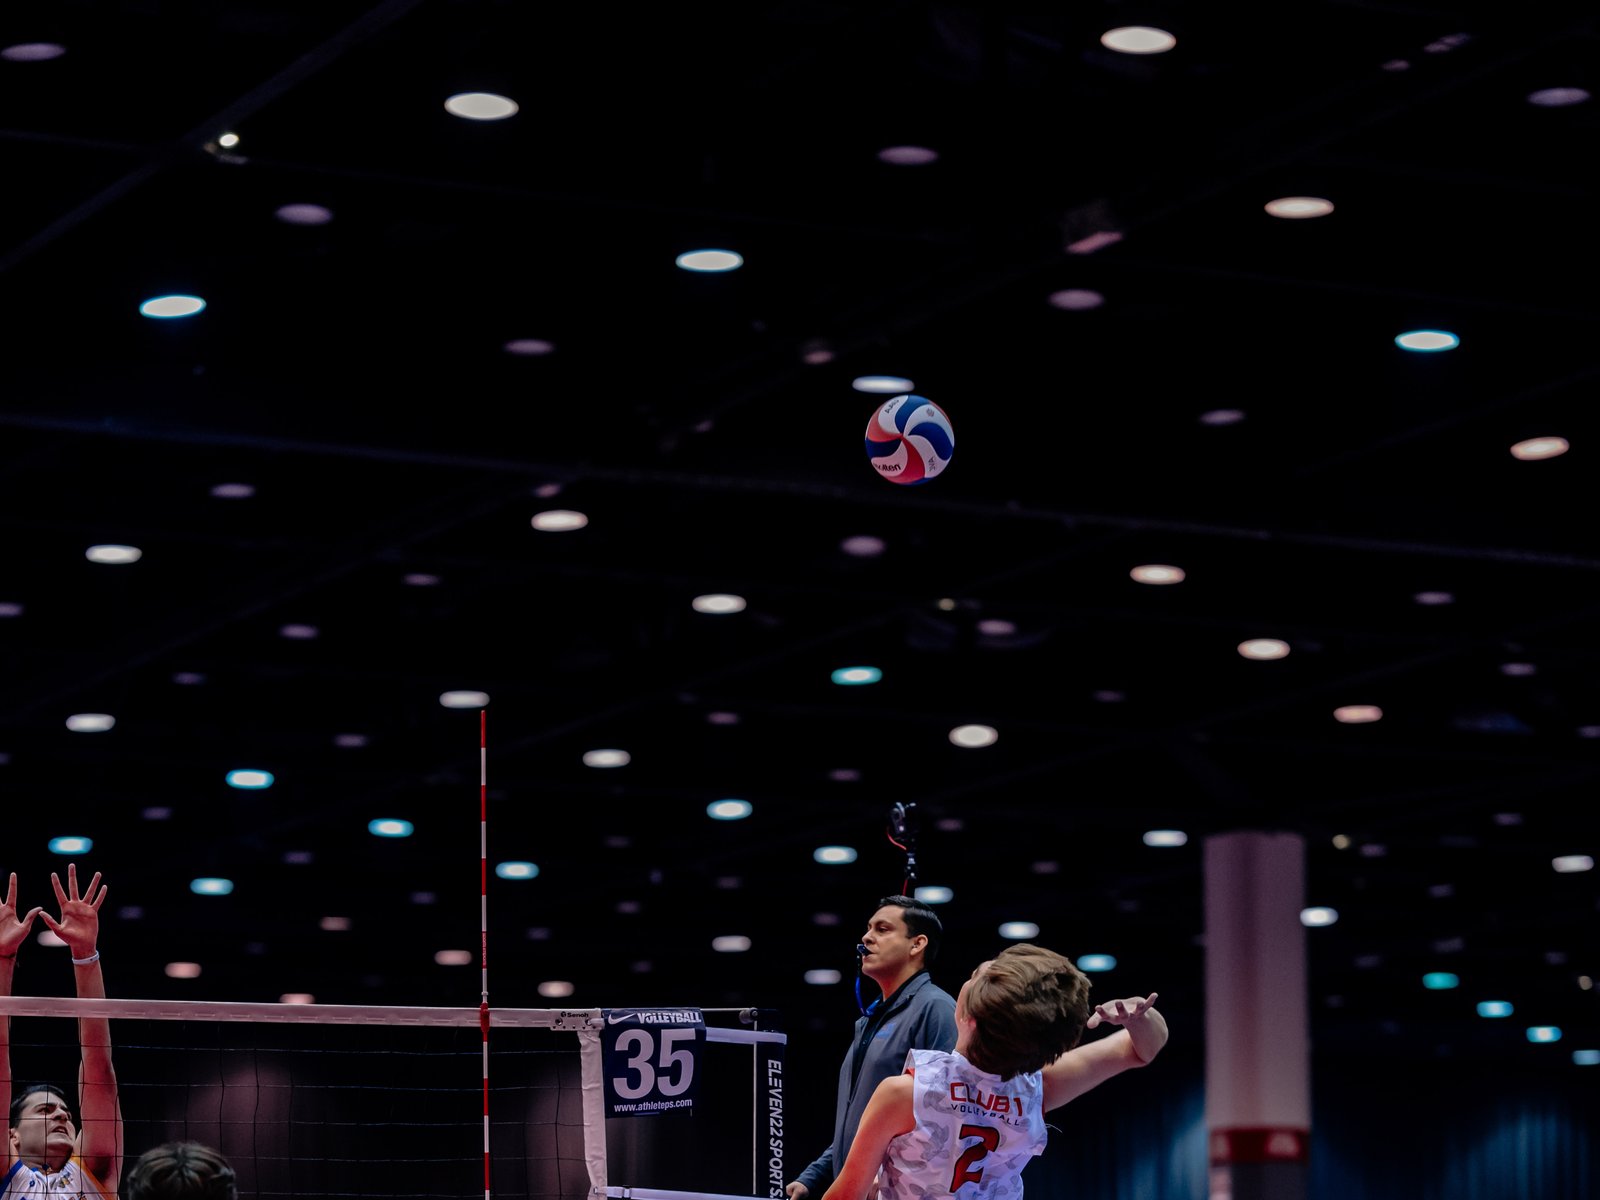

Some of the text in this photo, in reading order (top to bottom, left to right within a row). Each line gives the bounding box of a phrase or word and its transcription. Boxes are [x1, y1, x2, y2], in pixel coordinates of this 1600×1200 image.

[637, 1011, 702, 1024] VOLLEYBALL
[613, 1028, 696, 1099] 35
[614, 1099, 693, 1113] www.athleteps.com
[951, 1082, 1011, 1113] CLUB
[951, 1103, 1020, 1126] VOLLEYBALL
[949, 1123, 1000, 1193] 2
